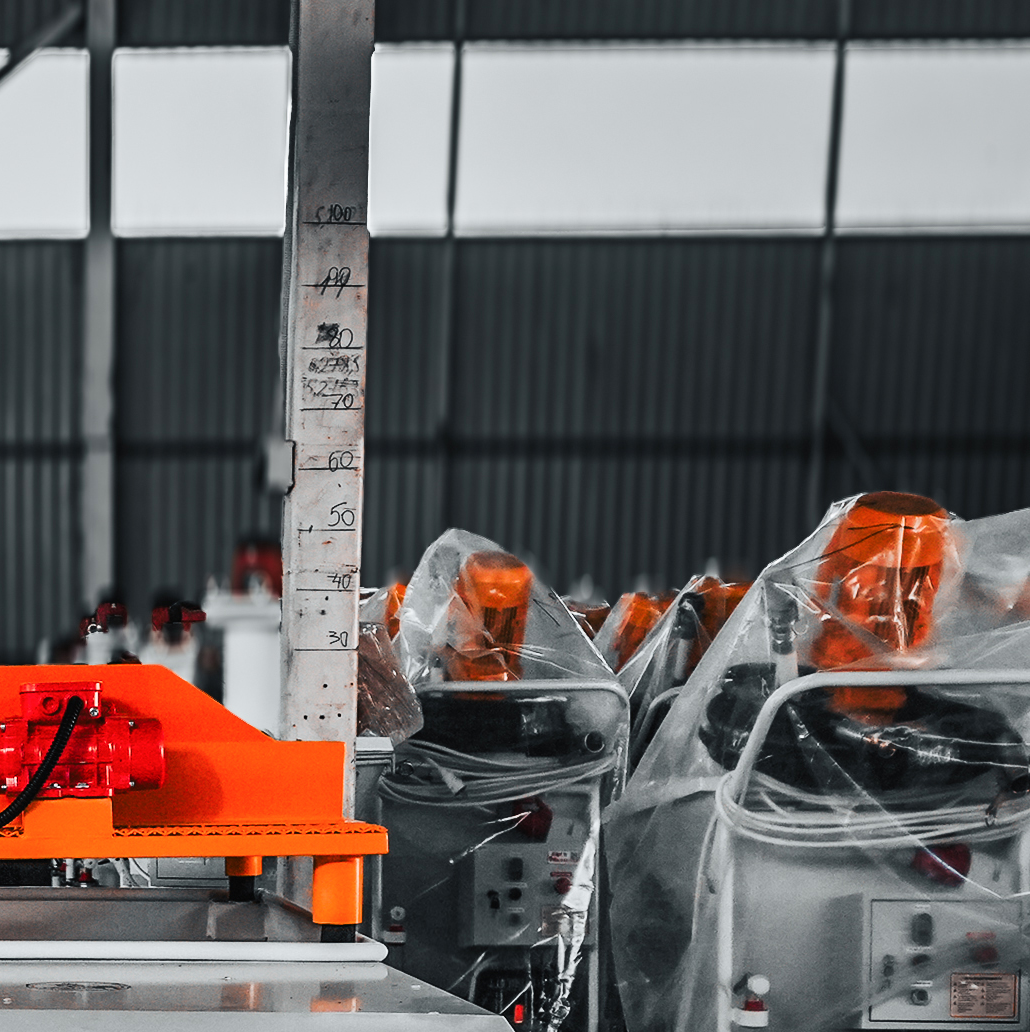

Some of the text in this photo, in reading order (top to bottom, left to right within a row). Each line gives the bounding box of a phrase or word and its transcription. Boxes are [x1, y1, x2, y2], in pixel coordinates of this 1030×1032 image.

[321, 393, 354, 409] 70
[328, 450, 354, 472] 60
[328, 501, 355, 526] 50
[328, 573, 351, 589] 40
[328, 631, 348, 647] 30
